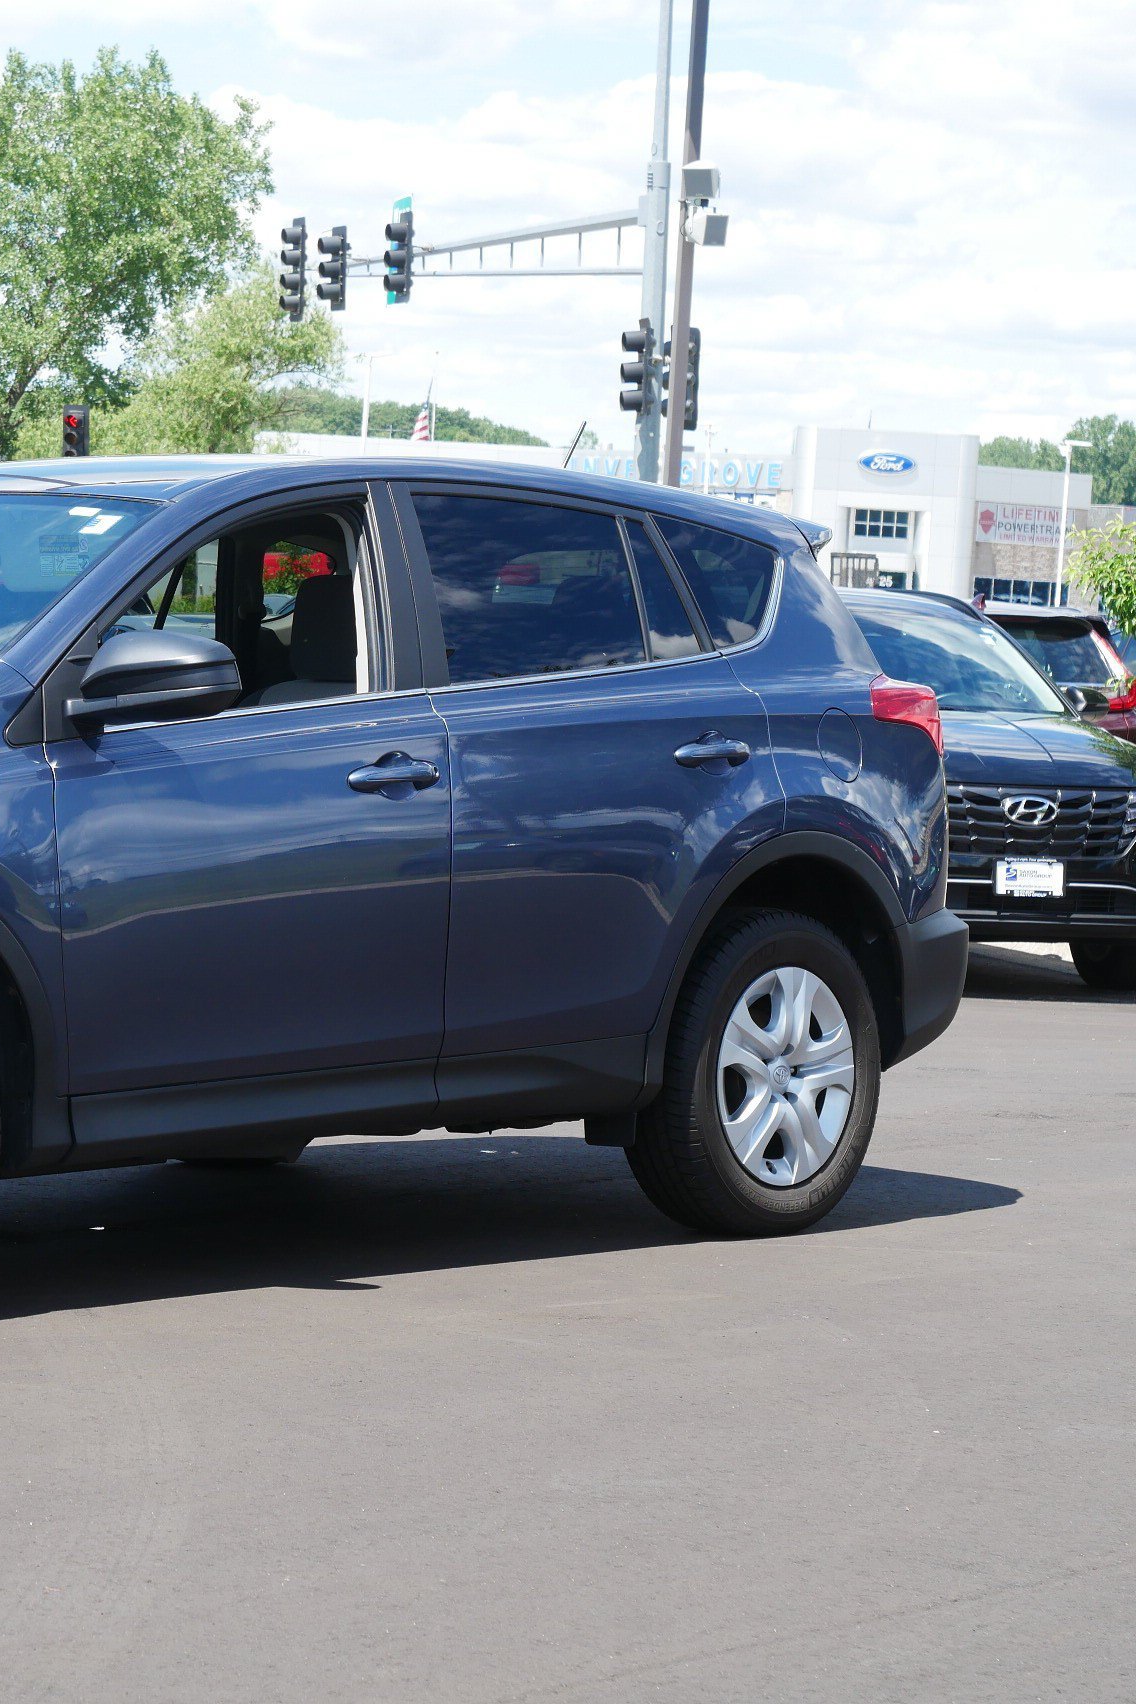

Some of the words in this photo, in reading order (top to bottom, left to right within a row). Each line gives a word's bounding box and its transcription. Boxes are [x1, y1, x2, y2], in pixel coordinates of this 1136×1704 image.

[870, 455, 905, 471] Ford
[570, 457, 637, 479] INVE
[680, 459, 783, 487] GROVE
[997, 521, 1072, 535] POWERTRAN
[1028, 534, 1065, 544] WARRAN
